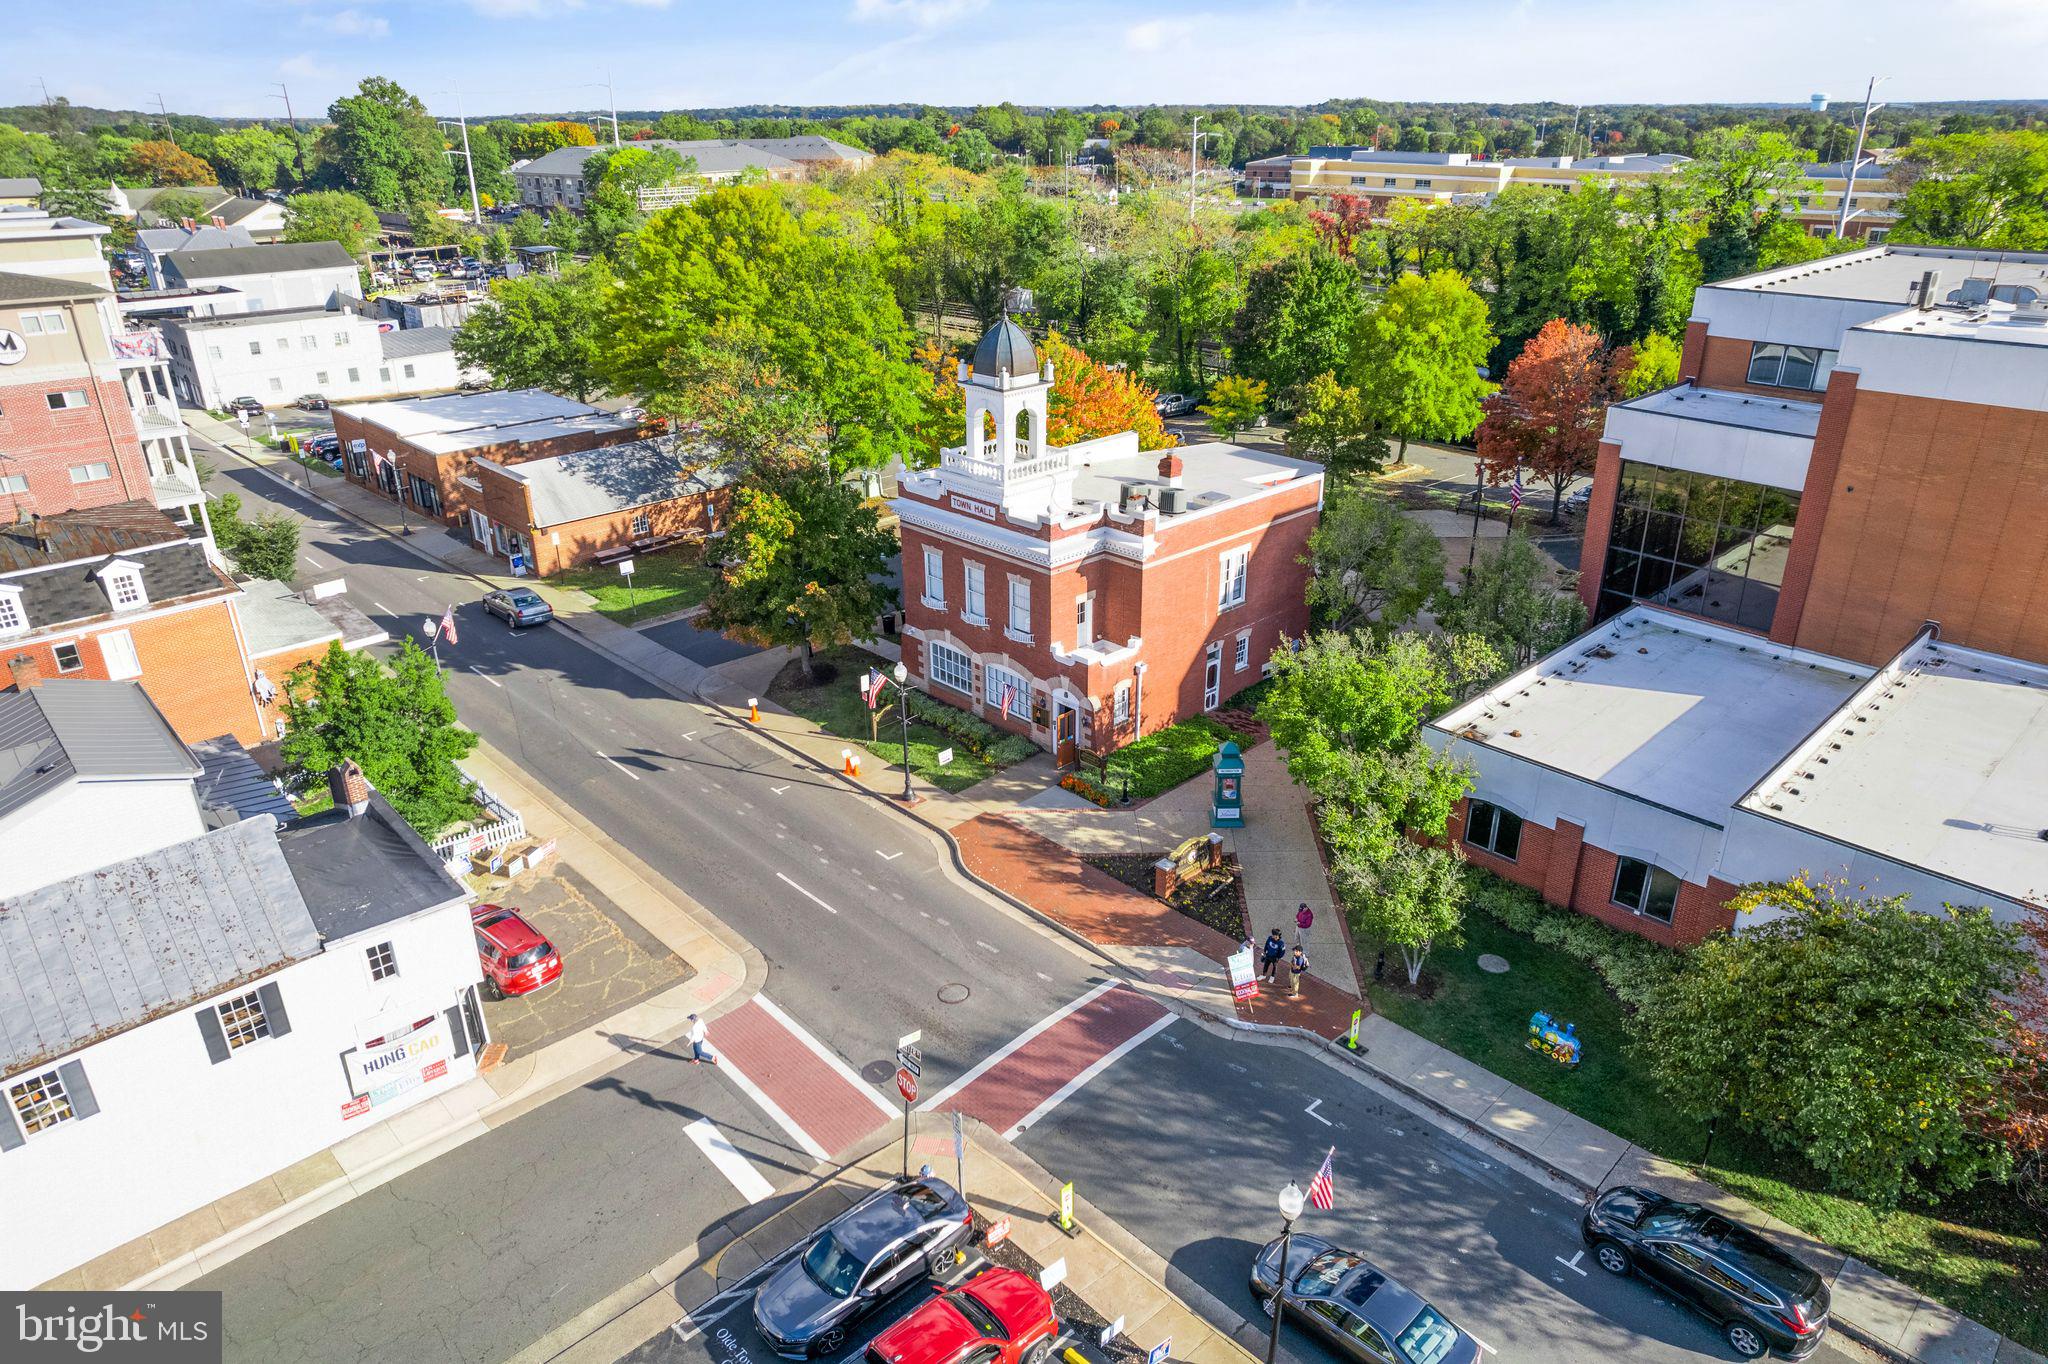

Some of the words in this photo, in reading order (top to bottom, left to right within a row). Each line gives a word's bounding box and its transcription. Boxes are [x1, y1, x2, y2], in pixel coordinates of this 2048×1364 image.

[952, 497, 972, 511] TOWN
[974, 504, 994, 518] HALL
[363, 1047, 406, 1075] HUNG
[408, 1035, 440, 1057] CAO
[897, 1073, 918, 1096] STOP
[716, 1328, 738, 1351] Olde
